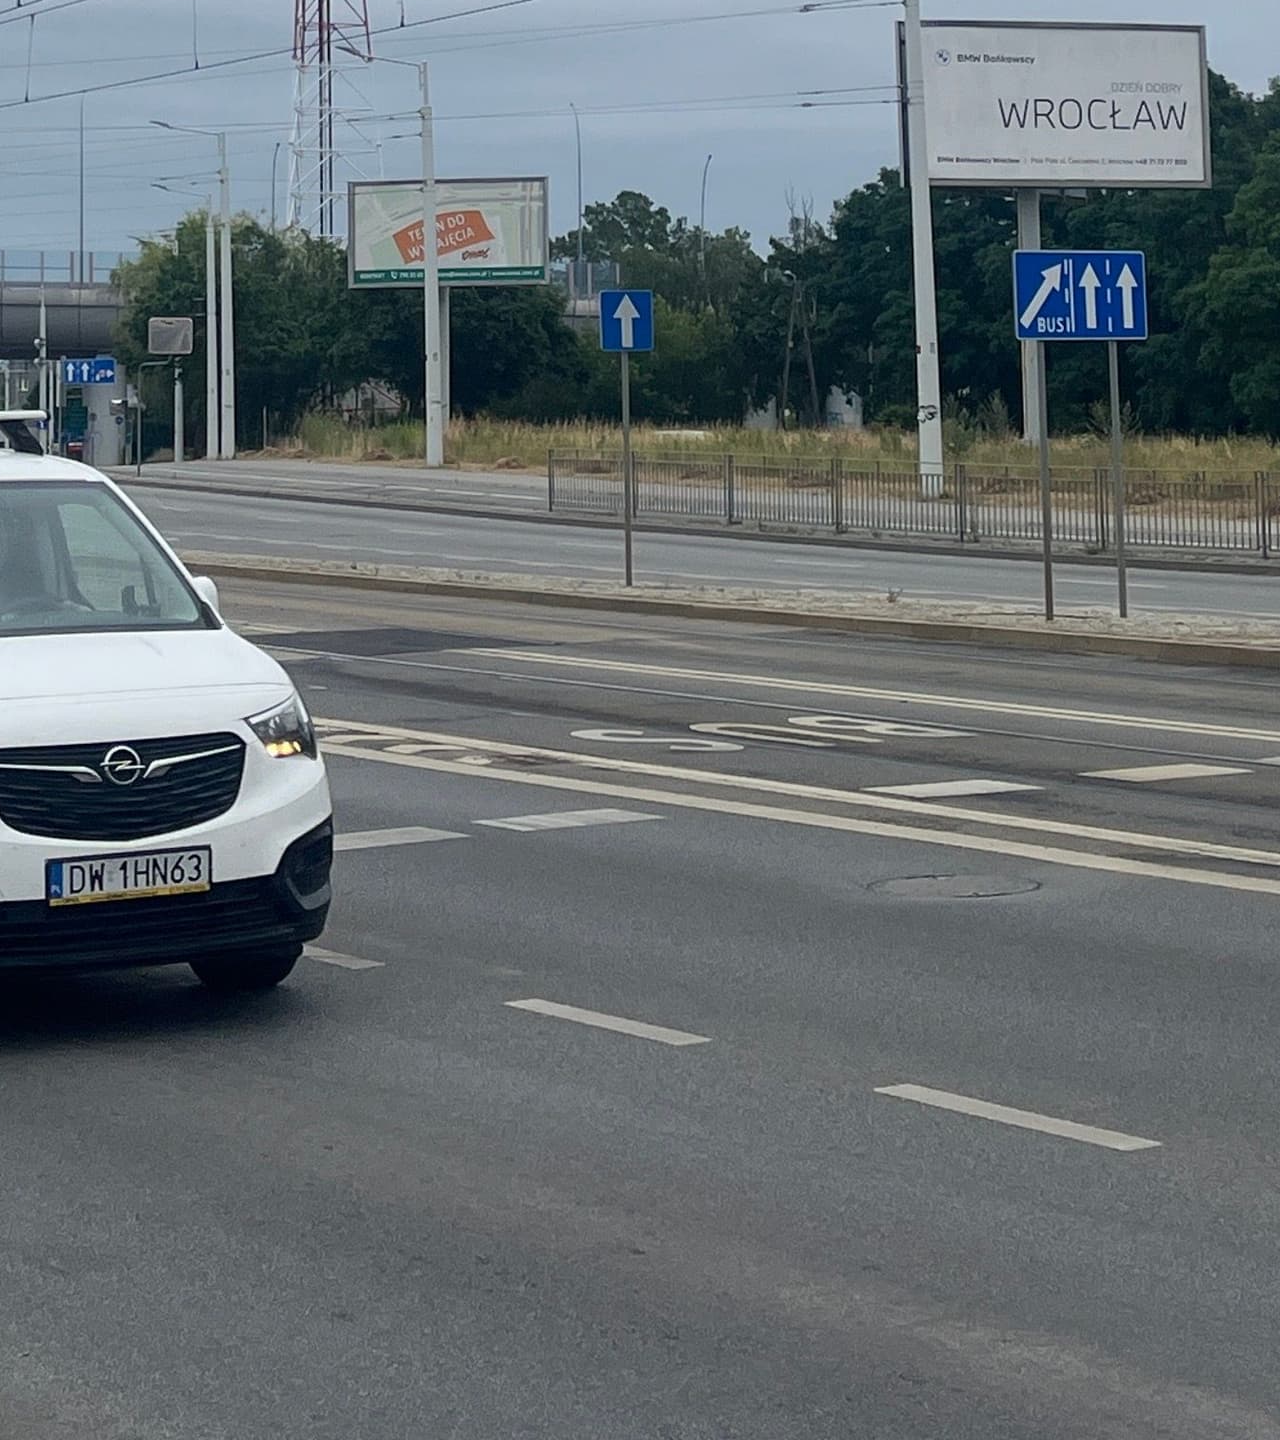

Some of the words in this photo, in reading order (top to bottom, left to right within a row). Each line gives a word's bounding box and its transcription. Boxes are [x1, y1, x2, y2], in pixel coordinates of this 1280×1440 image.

[957, 54, 981, 63] BMW
[1146, 82, 1183, 94] DOBRY
[998, 97, 1187, 131] WROCŁAW
[447, 214, 466, 229] DO
[1037, 316, 1065, 333] BUS
[570, 715, 976, 752] BUS
[70, 862, 105, 894] DW
[119, 854, 202, 889] 1HN63
